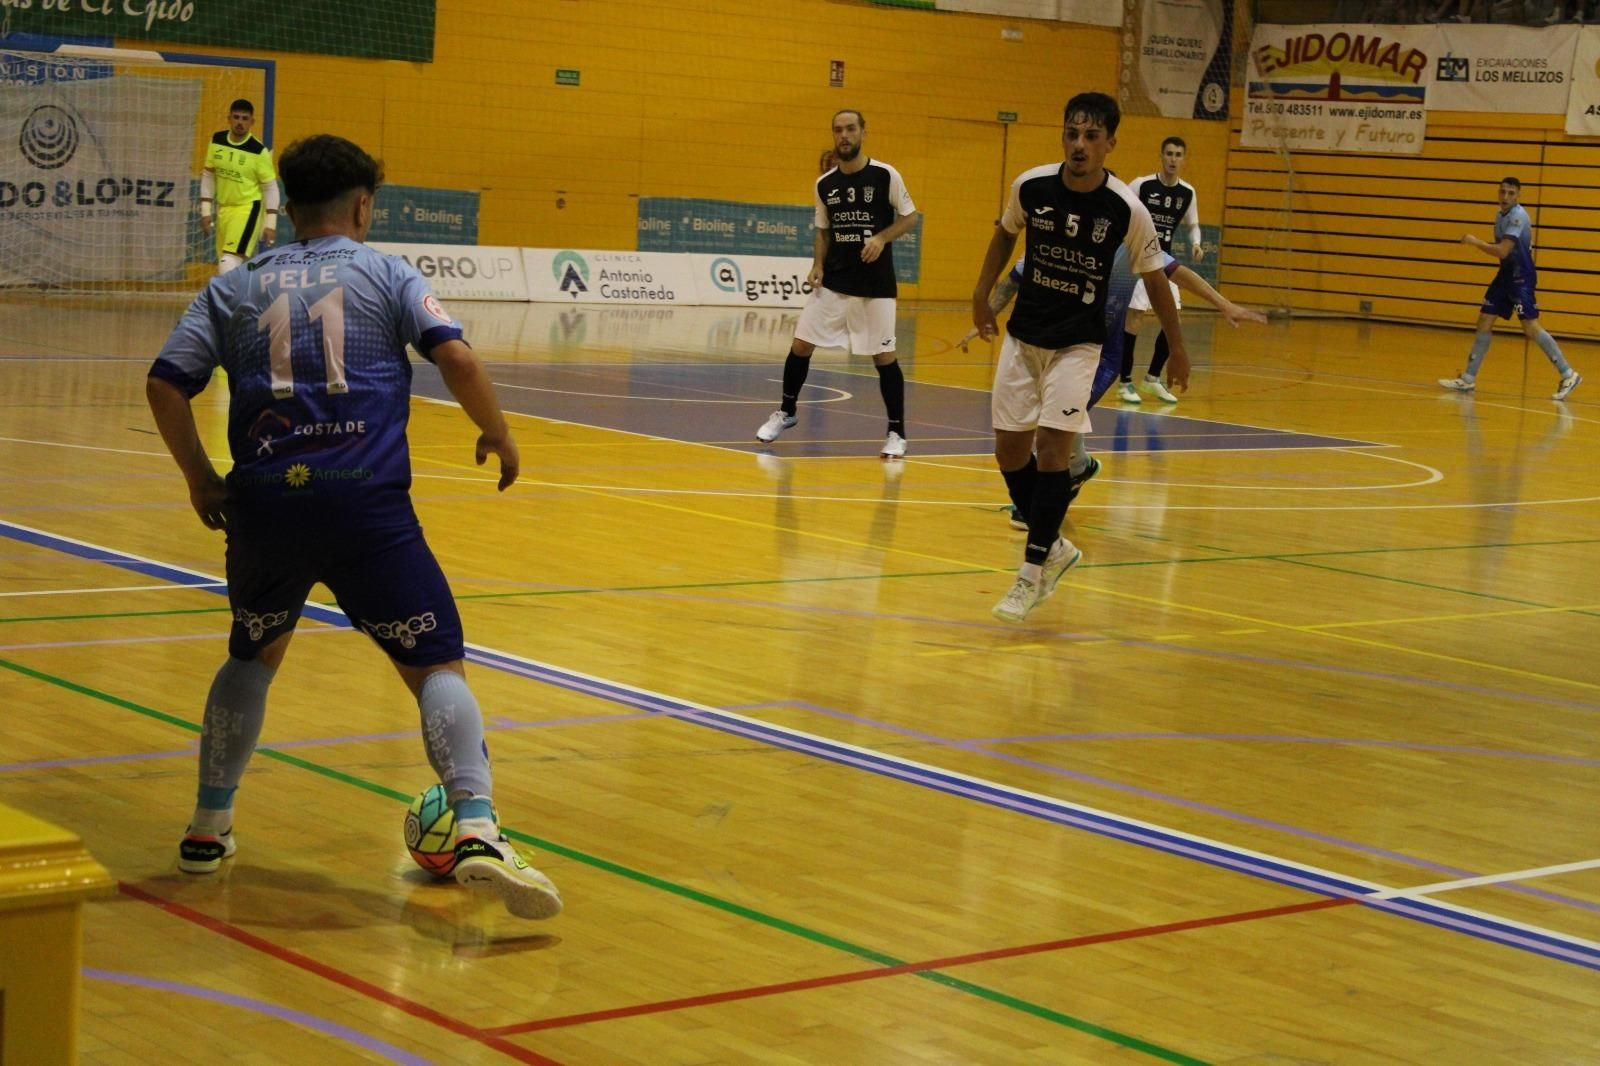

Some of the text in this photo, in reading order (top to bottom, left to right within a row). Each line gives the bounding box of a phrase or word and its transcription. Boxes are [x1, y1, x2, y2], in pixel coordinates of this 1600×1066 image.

[1253, 32, 1428, 84] EJIDOMAR
[1476, 58, 1548, 68] EXCAVACIONES
[1475, 70, 1564, 83] LOS MELLIZOS
[1286, 104, 1323, 116] 483511
[1329, 106, 1422, 120] www.ejidomar.es
[1252, 119, 1416, 146] Presente y Futuro
[847, 187, 855, 202] 3
[1164, 196, 1171, 208] 8
[415, 207, 463, 225] Bioline
[834, 210, 871, 222] ceuta
[693, 218, 736, 233] Bioline
[756, 221, 798, 236] Bioline
[1065, 213, 1080, 237] 5
[835, 232, 861, 242] Baeza
[1039, 243, 1097, 271] ceuta
[260, 265, 337, 293] PELE
[600, 269, 653, 283] Antonio
[1032, 268, 1079, 295] Baeza
[600, 284, 675, 300] Castañeda
[258, 287, 349, 399] 11
[293, 420, 366, 435] COSTA DE
